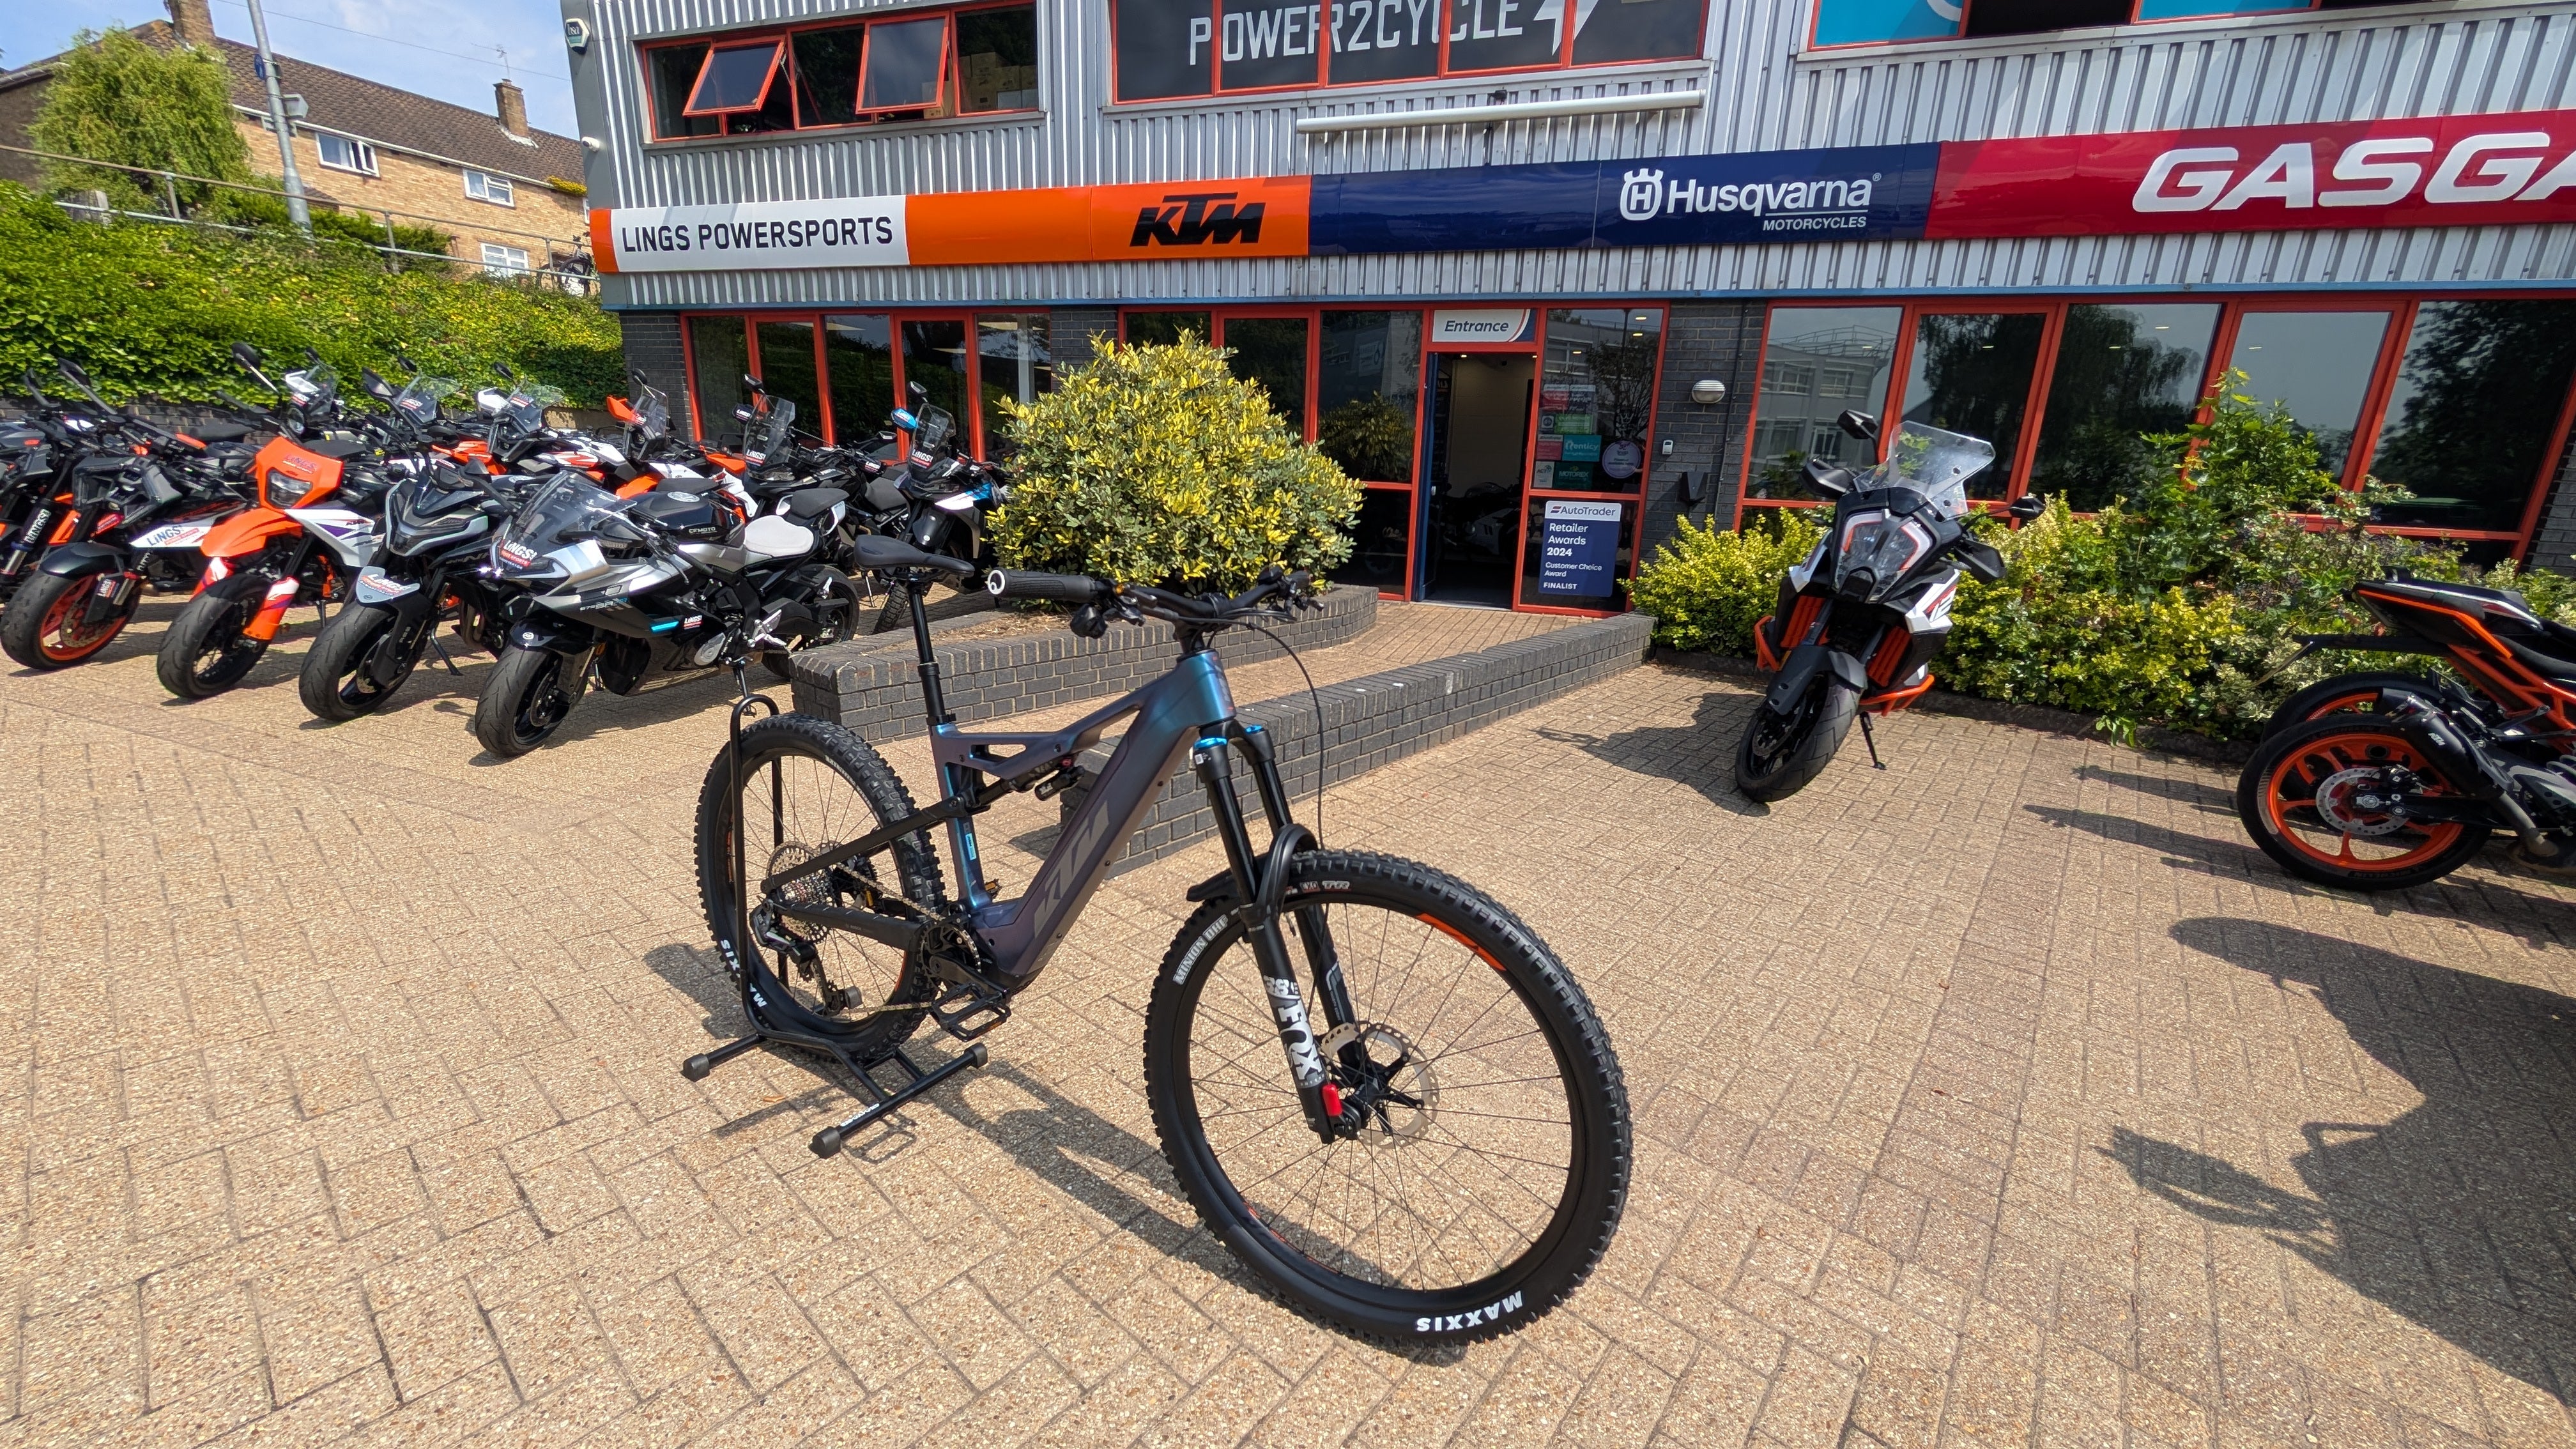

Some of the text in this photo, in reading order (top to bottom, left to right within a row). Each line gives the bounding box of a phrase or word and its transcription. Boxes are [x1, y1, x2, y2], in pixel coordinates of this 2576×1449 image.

[1666, 178, 1873, 217] Husqvarna
[1129, 192, 1266, 248] KTM
[1763, 217, 1866, 231] MOTORCYCLES
[622, 216, 893, 253] LINGS POWERSPORTS
[1444, 319, 1509, 334] Entrance
[1560, 507, 1616, 516] AutoTrader
[1549, 523, 1588, 533] Retailer
[1547, 535, 1586, 545] Awards
[1547, 548, 1572, 556] 2024
[1545, 562, 1578, 570] Customer
[2428, 732, 2446, 746] KTM
[1172, 914, 1229, 985] MINION DHF
[1278, 1000, 1323, 1080] FOX
[1416, 1290, 1523, 1333] MAXXIS
